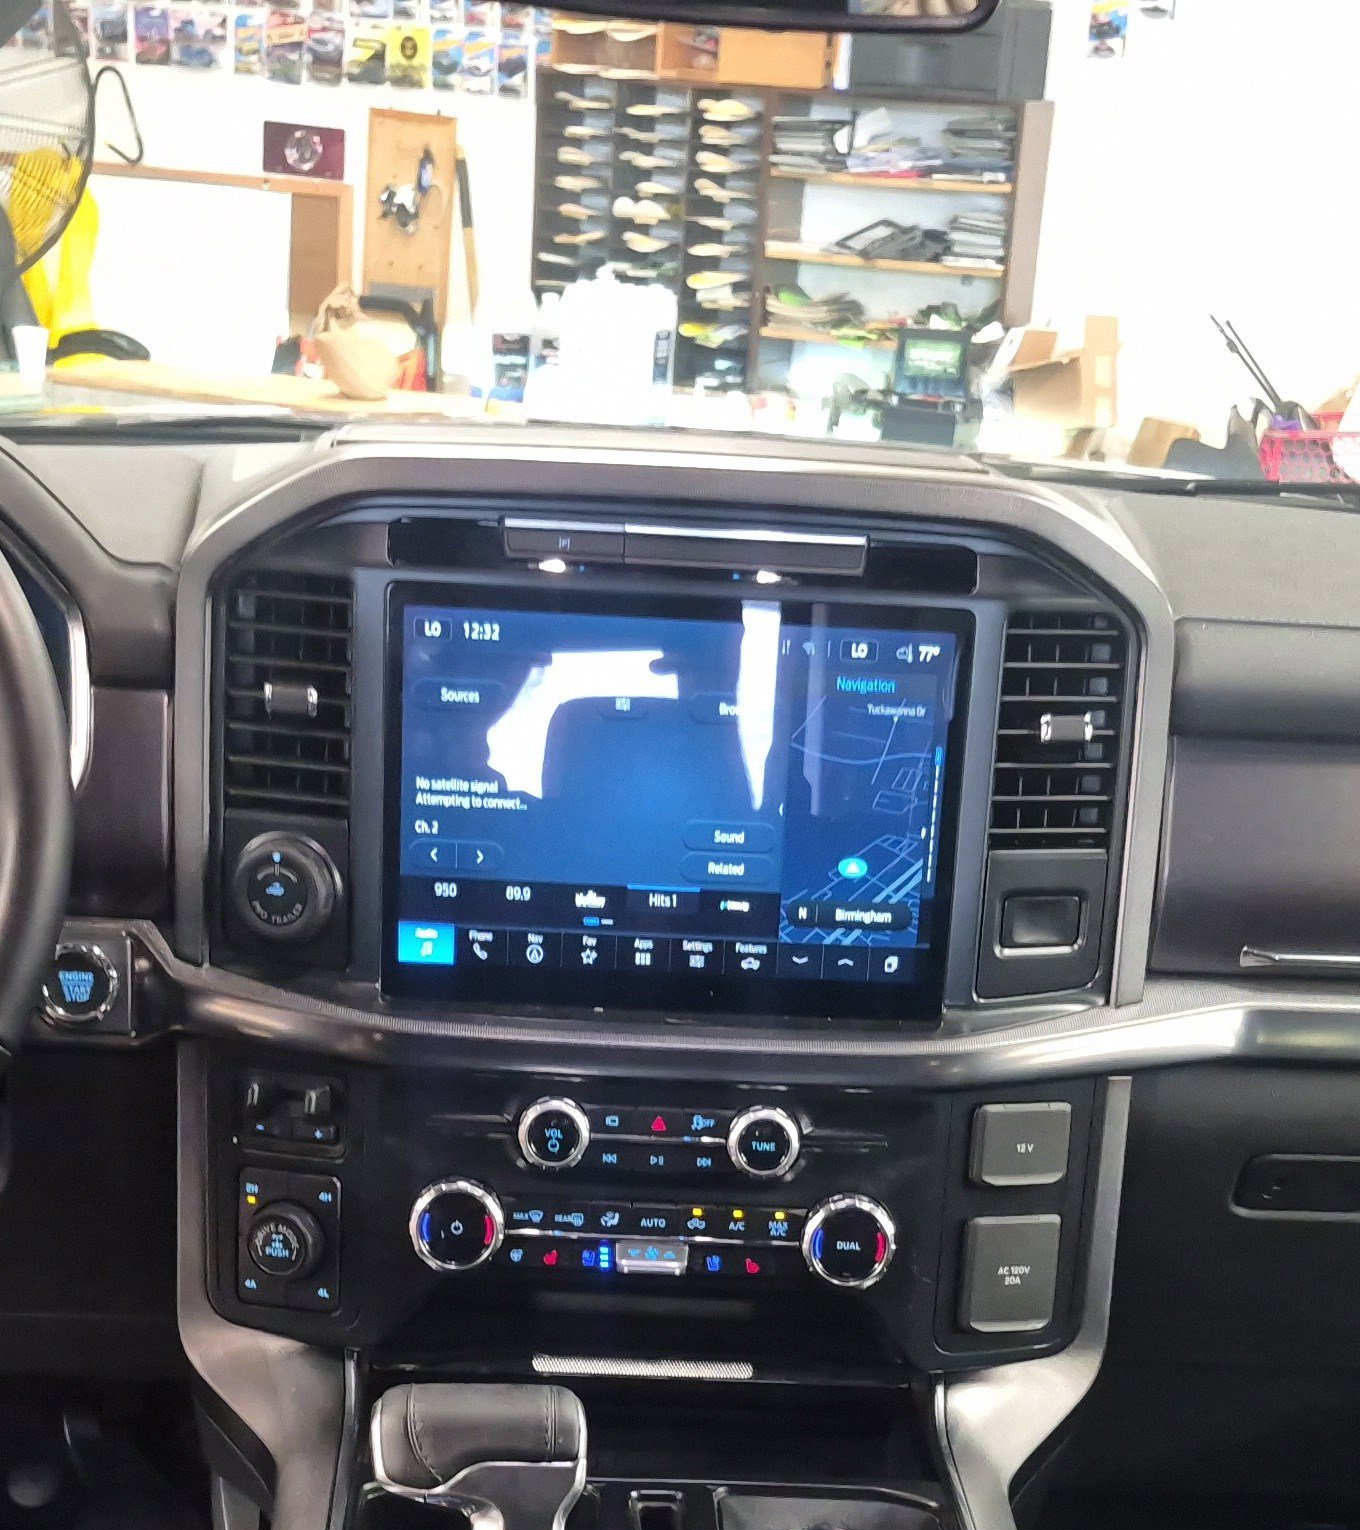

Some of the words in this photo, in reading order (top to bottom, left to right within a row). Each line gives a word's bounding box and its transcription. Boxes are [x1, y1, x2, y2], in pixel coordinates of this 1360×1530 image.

[424, 621, 442, 637] LO
[463, 622, 500, 641] 12:32
[851, 642, 868, 658] LO
[836, 676, 896, 693] Navigation
[415, 776, 430, 790] No
[431, 778, 469, 792] satellite
[471, 780, 499, 794] signal
[415, 795, 470, 810] Attempting
[472, 796, 482, 808] to
[414, 820, 431, 834] Ch.
[714, 830, 745, 845] Sound
[707, 862, 745, 877] Related
[649, 893, 669, 907] Hits
[835, 908, 892, 925] Birmingham
[527, 933, 544, 944] Nav
[544, 1128, 563, 1139] VOL
[751, 1140, 777, 1152] TUNE
[640, 1217, 666, 1228] AUTO
[728, 1221, 746, 1232] A/C
[768, 1221, 789, 1230] MAX
[836, 1240, 860, 1251] DUAL
[997, 1265, 1009, 1276] AC
